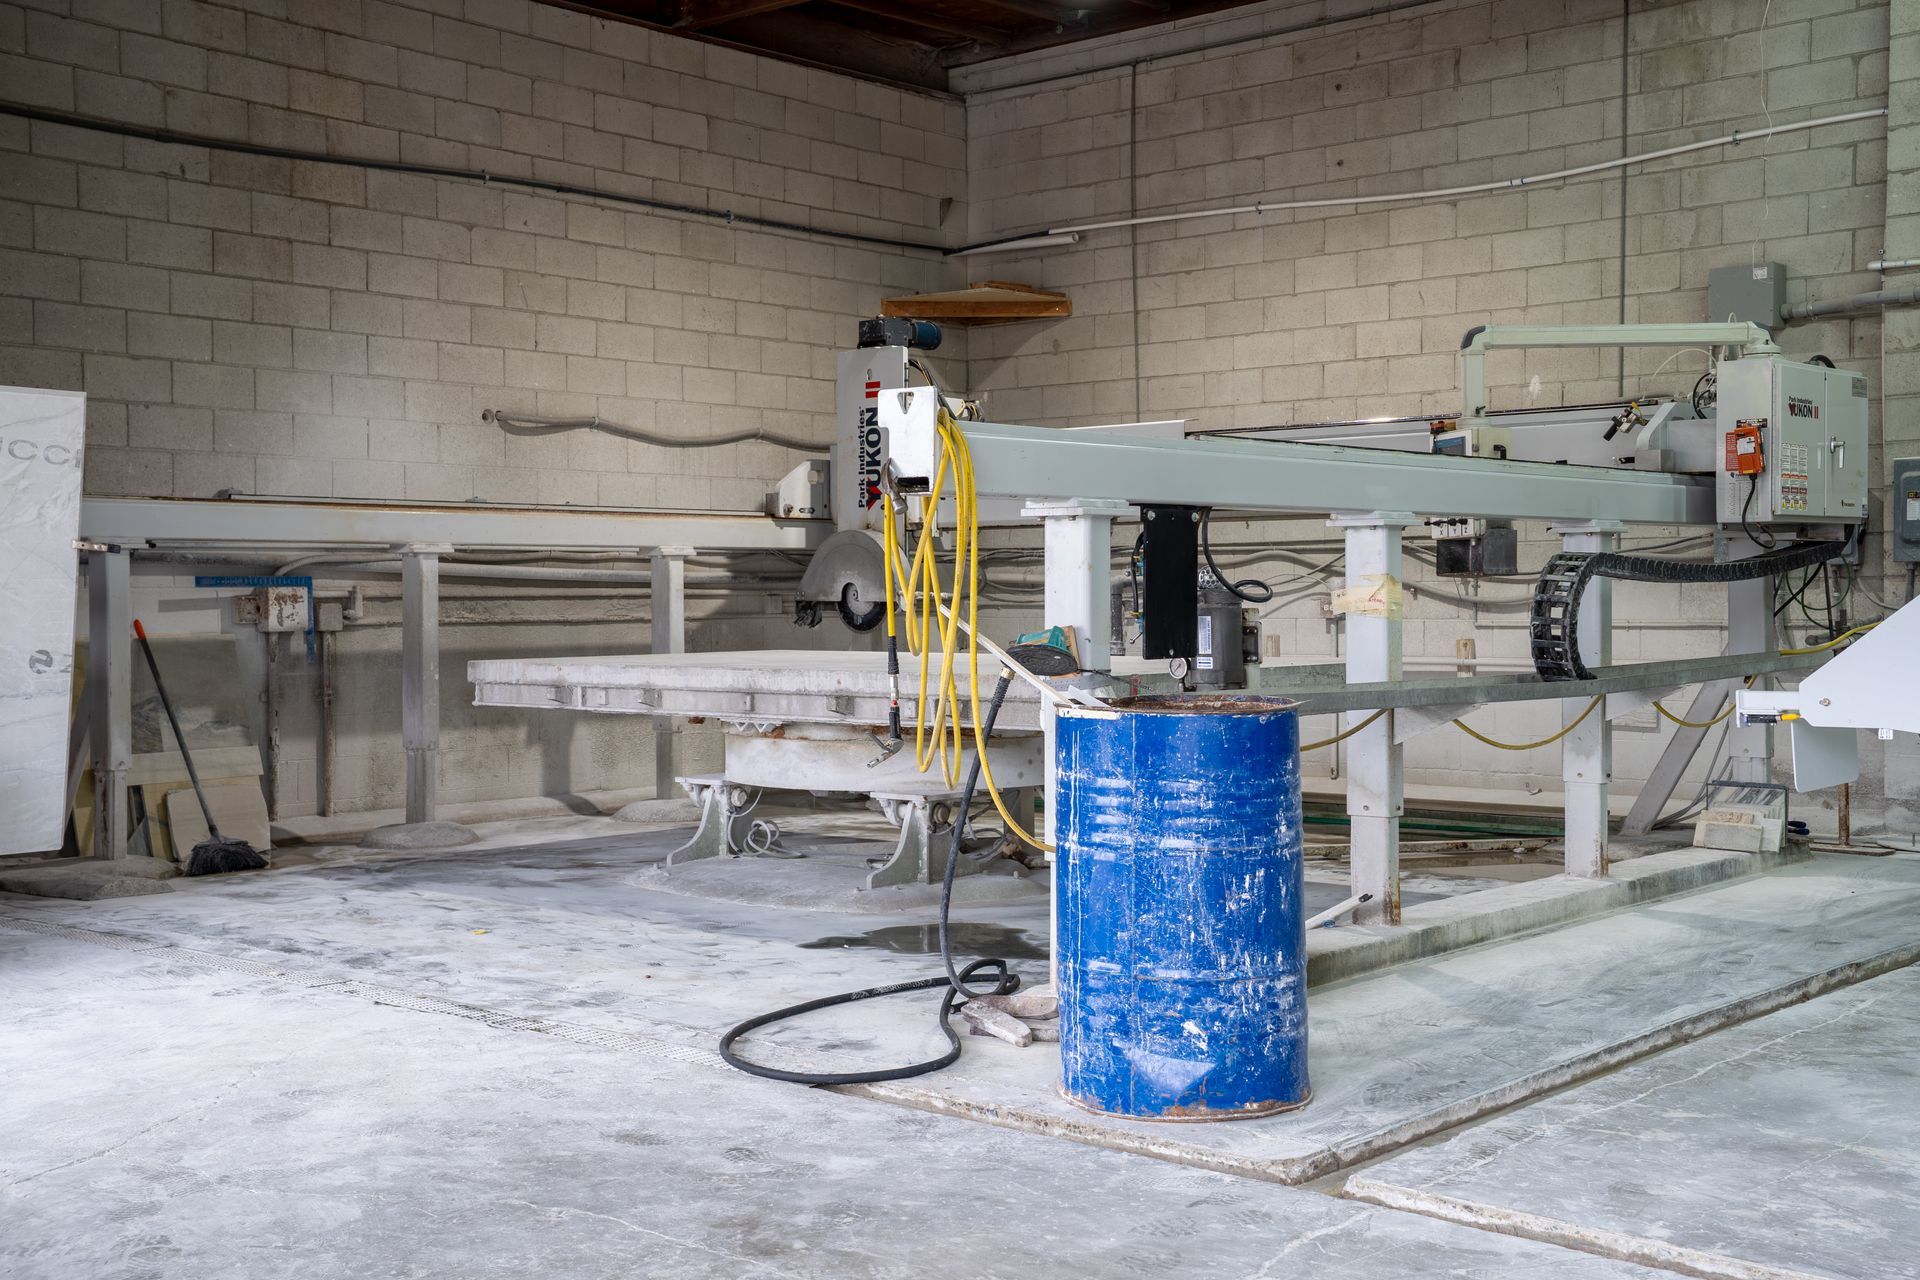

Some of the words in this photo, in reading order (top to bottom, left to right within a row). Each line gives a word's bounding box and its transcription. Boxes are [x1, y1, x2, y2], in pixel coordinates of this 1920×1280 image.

[1788, 403, 1813, 418] YUKON
[858, 409, 866, 476] Industries
[866, 407, 882, 511] YUKON
[858, 479, 866, 508] Park
